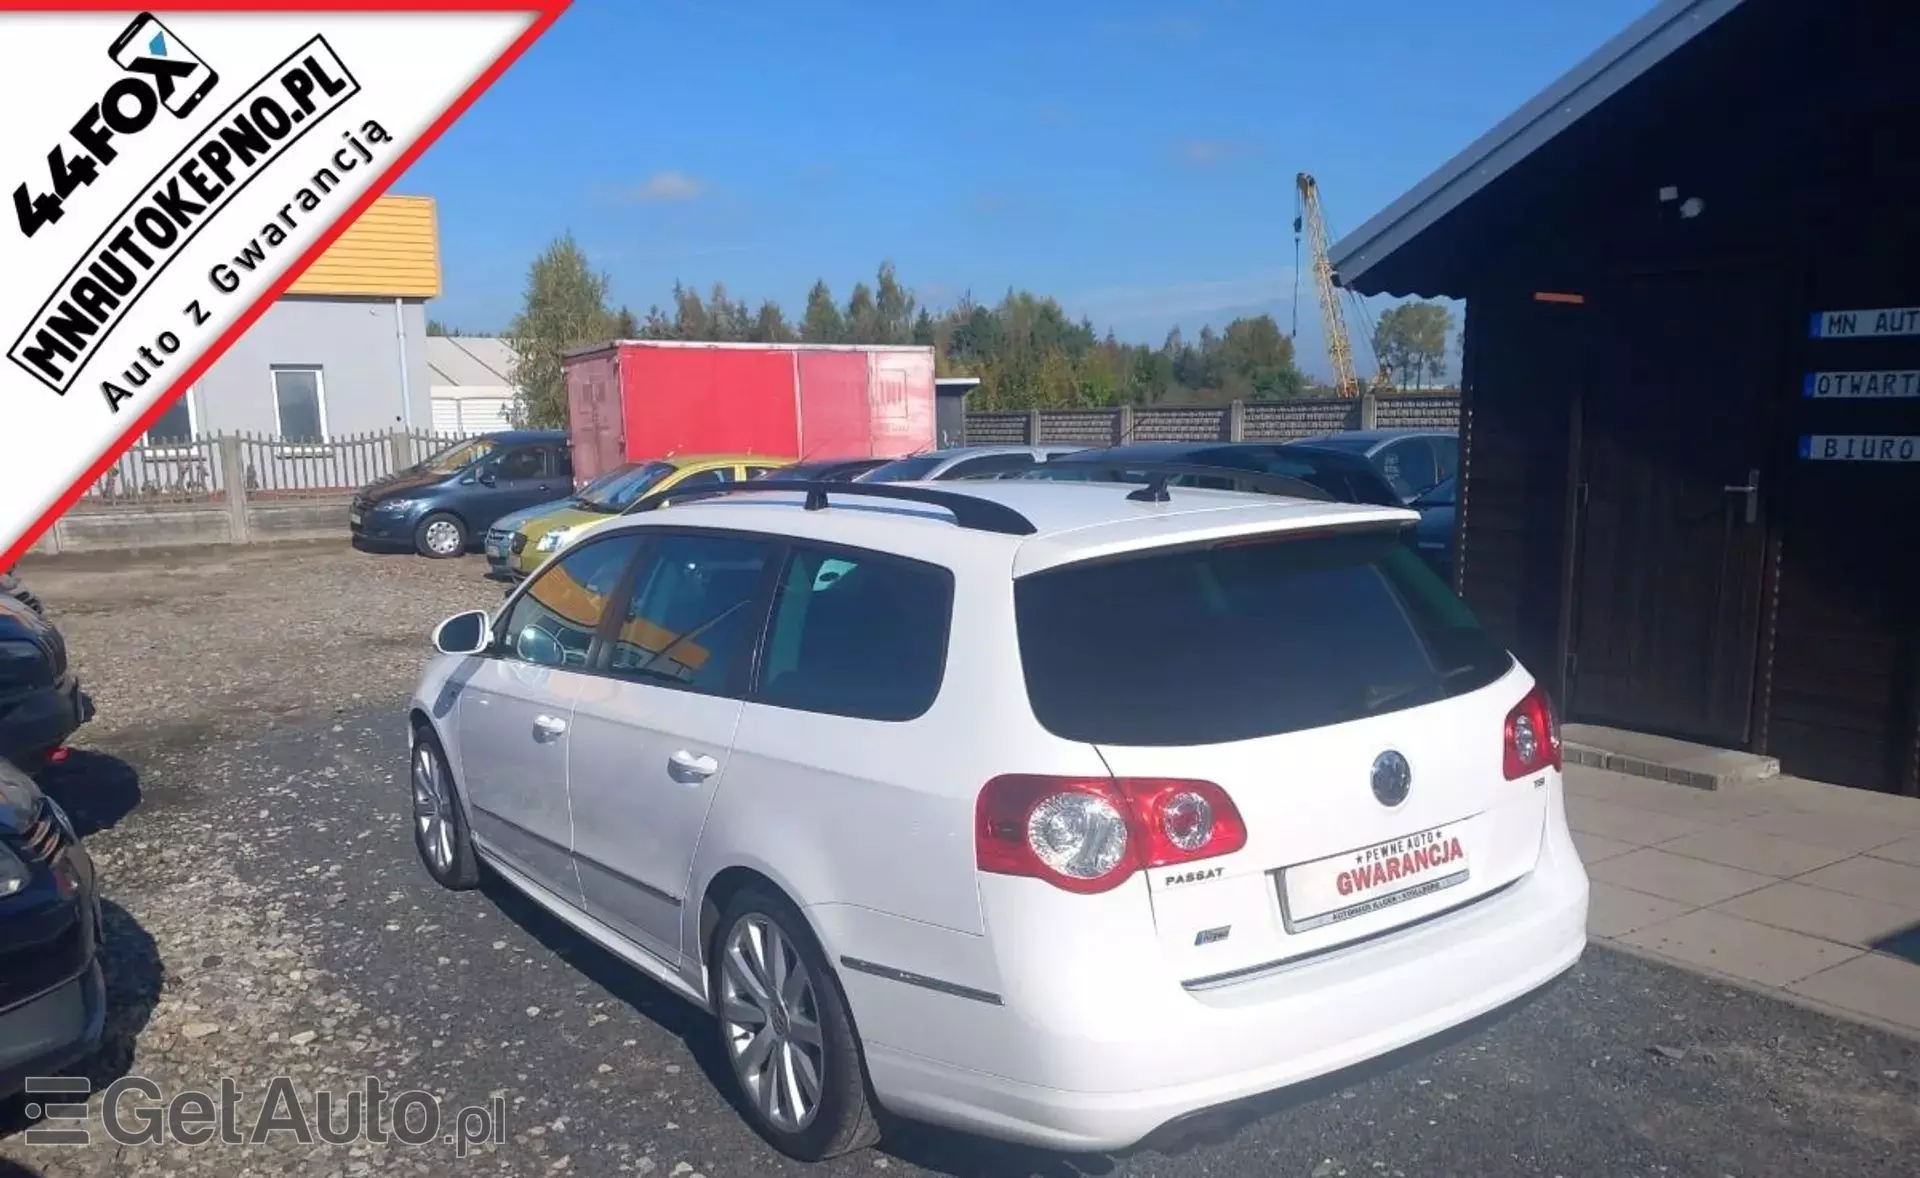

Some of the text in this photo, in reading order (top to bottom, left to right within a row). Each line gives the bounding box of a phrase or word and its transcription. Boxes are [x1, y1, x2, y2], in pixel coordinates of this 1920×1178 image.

[1828, 310, 1920, 334] MN AUT
[1818, 374, 1920, 395] OTWART
[1824, 438, 1914, 460] BIURO
[1366, 831, 1434, 862] PEWNE AUTO
[1165, 867, 1226, 887] PASSAT
[1336, 836, 1464, 896] GWARANCJA
